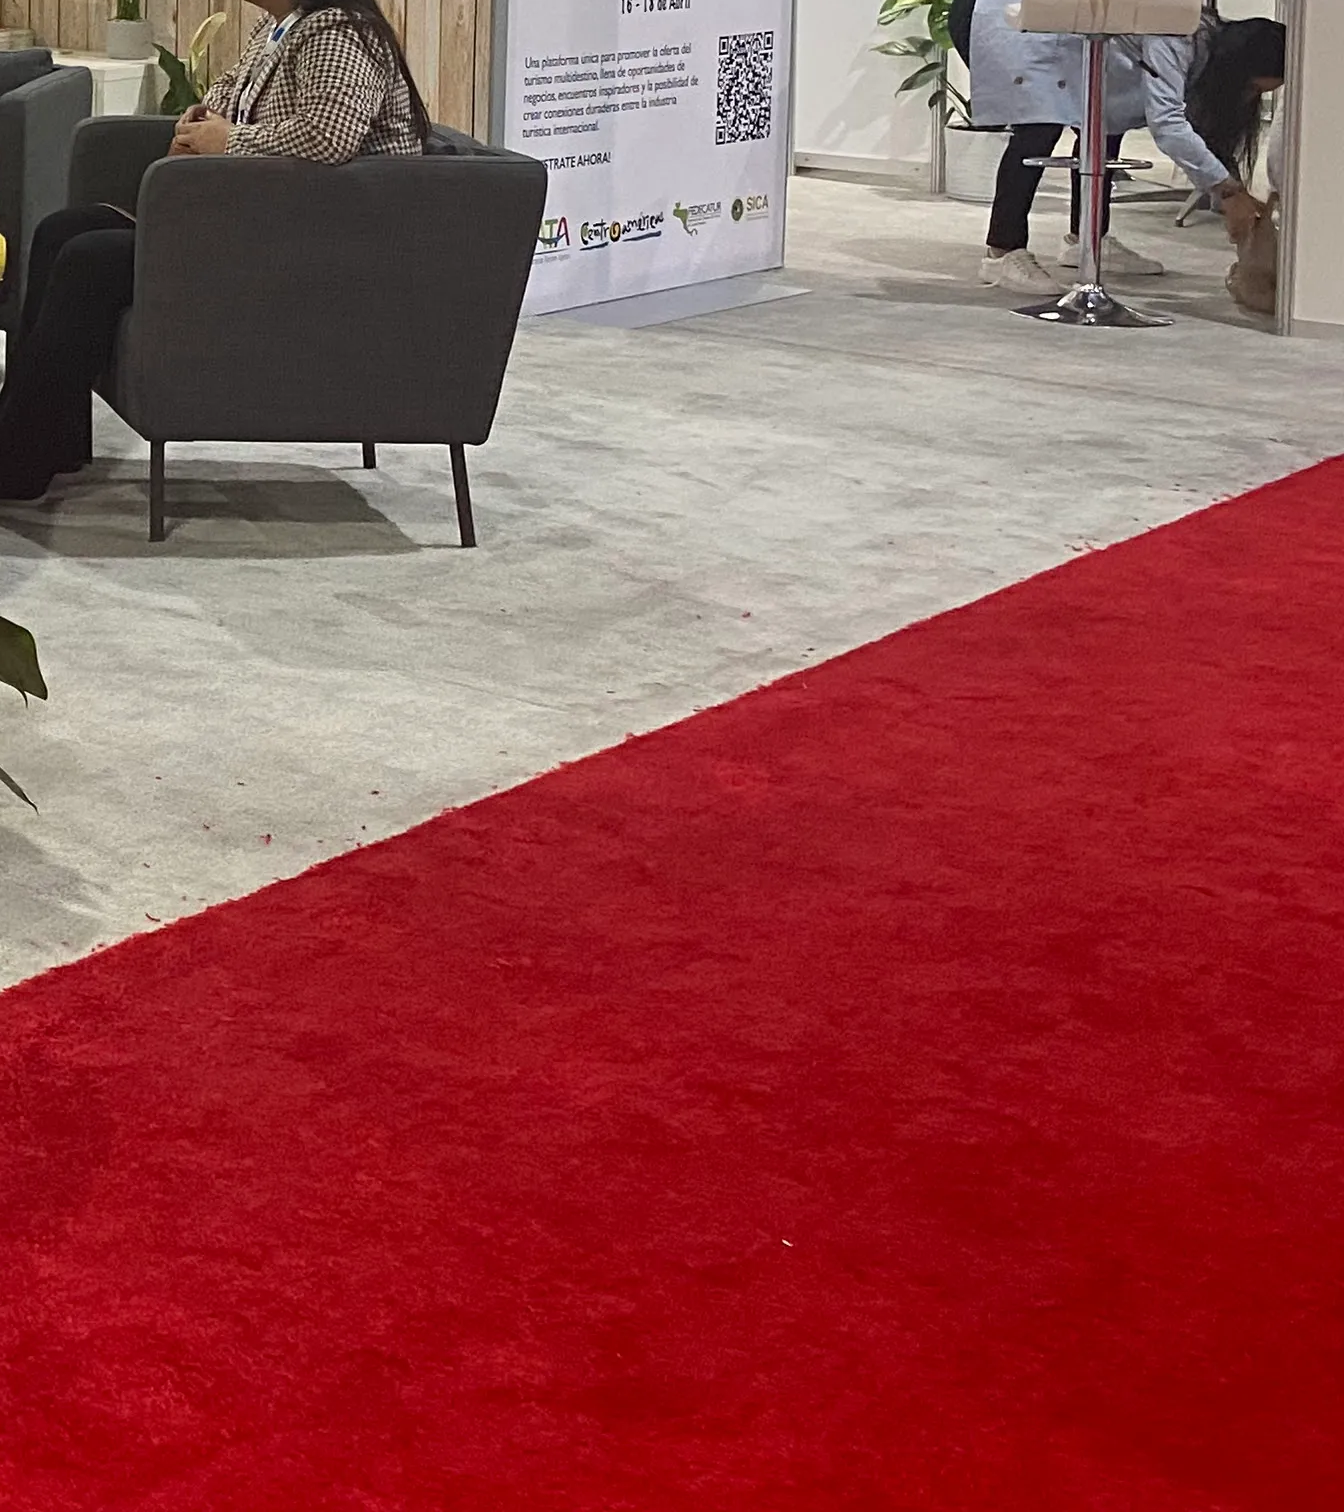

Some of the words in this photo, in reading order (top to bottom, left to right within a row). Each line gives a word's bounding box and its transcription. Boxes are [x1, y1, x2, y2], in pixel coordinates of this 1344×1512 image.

[600, 53, 615, 66] para
[617, 65, 626, 77] de
[677, 60, 685, 72] de
[690, 75, 699, 86] de
[577, 151, 611, 168] AHORA!
[746, 195, 769, 211] SICA
